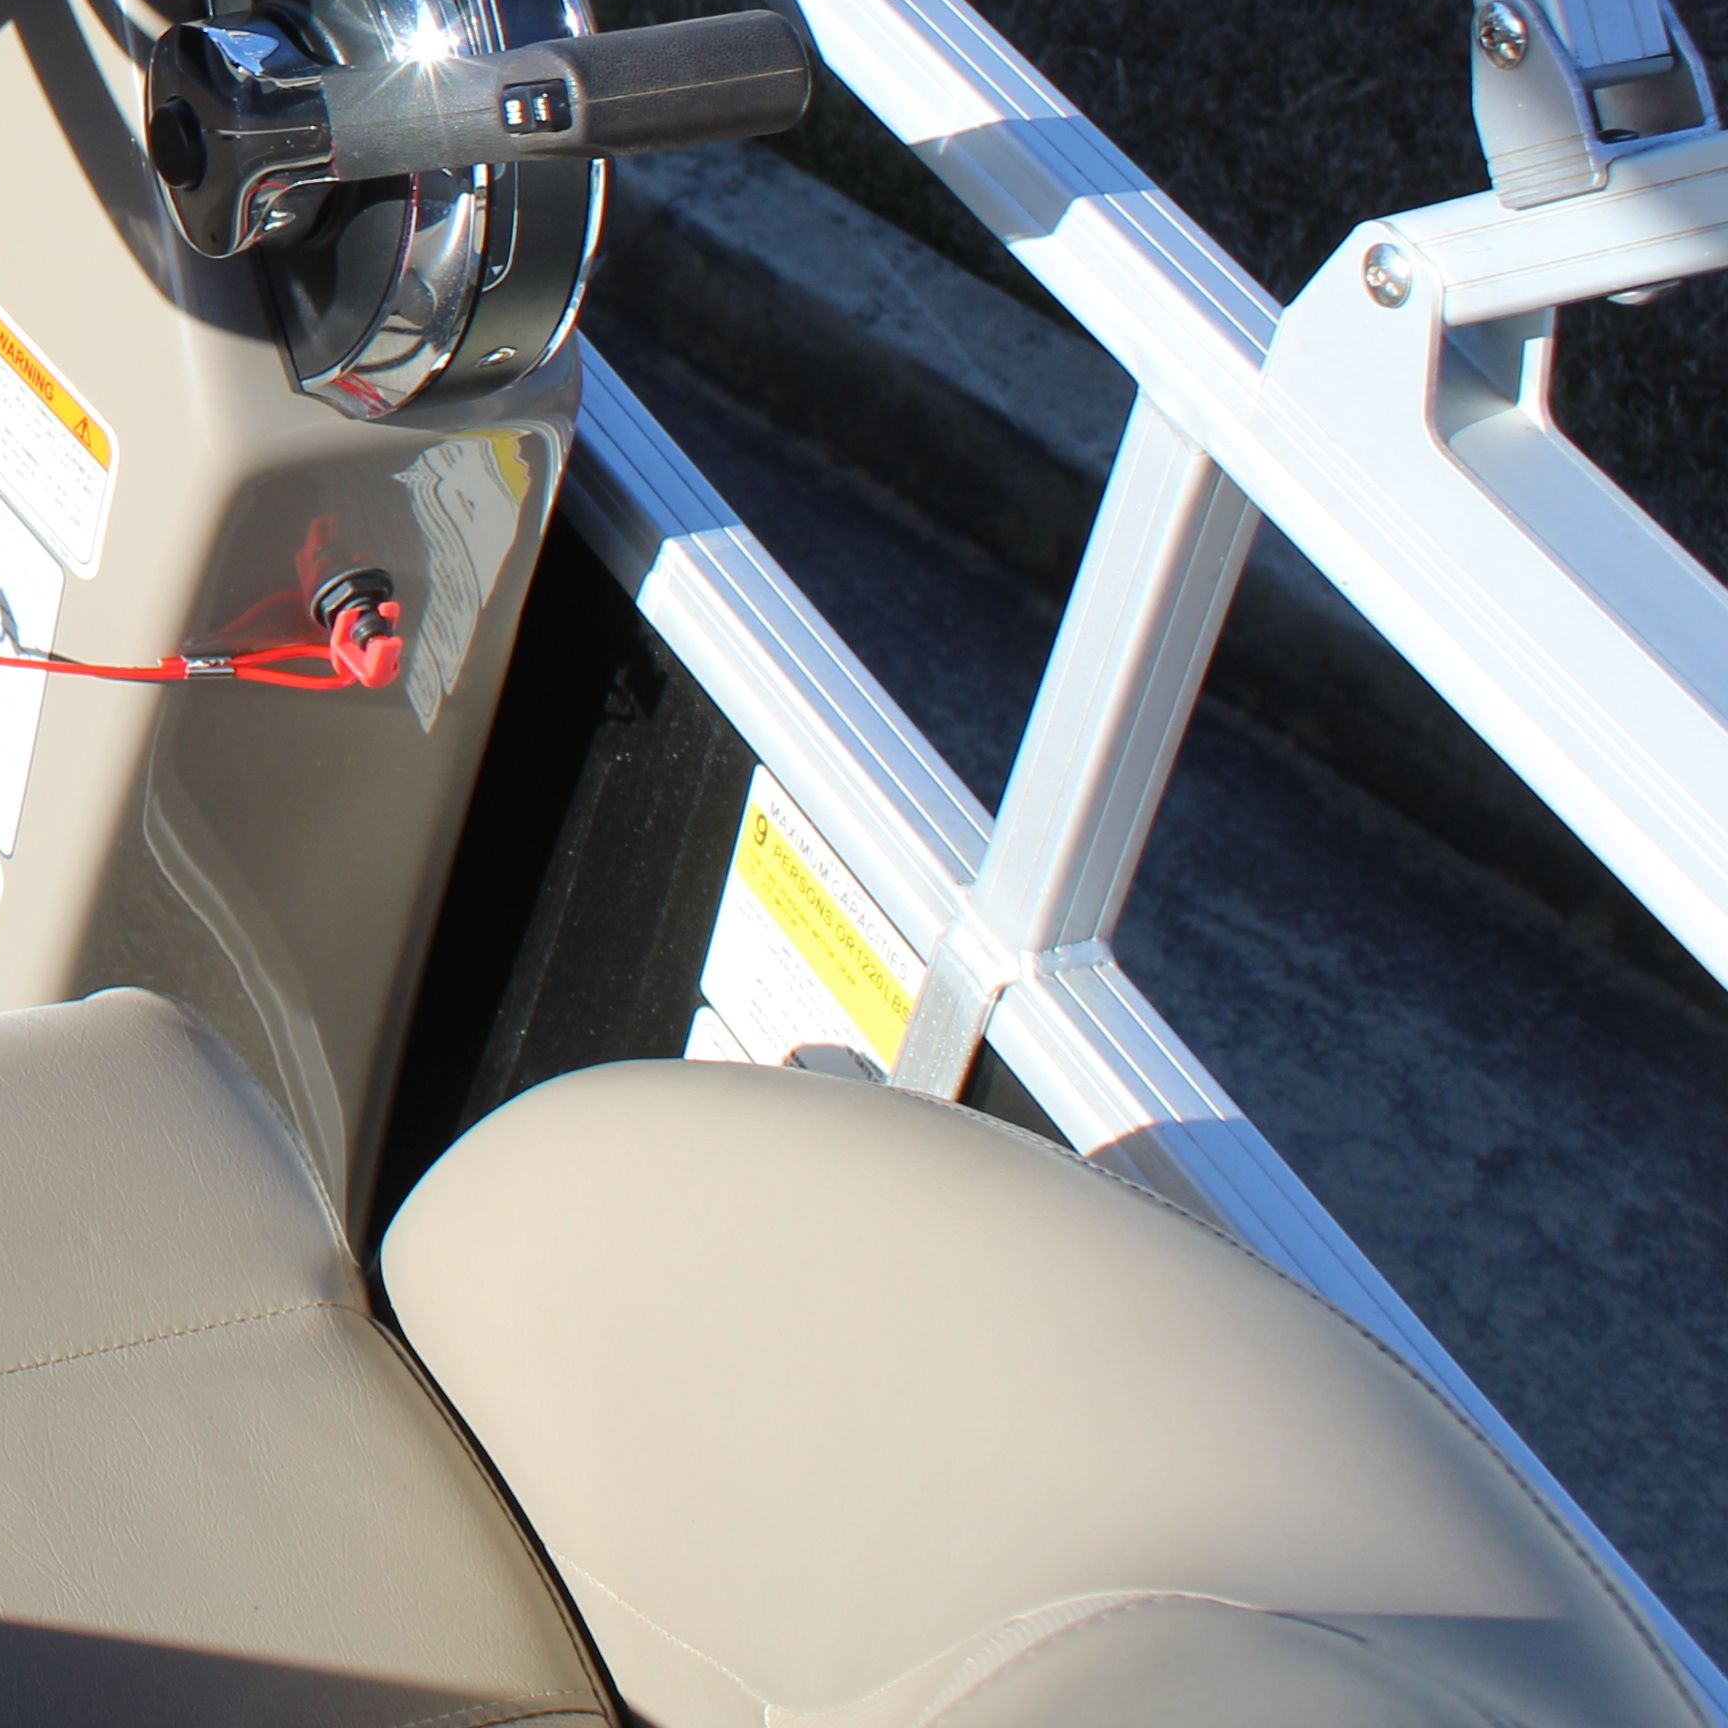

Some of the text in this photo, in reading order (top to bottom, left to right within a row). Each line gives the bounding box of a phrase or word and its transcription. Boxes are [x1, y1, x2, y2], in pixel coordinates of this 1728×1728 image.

[754, 813, 768, 846] 9
[772, 844, 834, 928] PERSONS
[834, 923, 857, 959] OR
[769, 800, 831, 881] MAXIMUM
[831, 878, 909, 982] CAPACITIES
